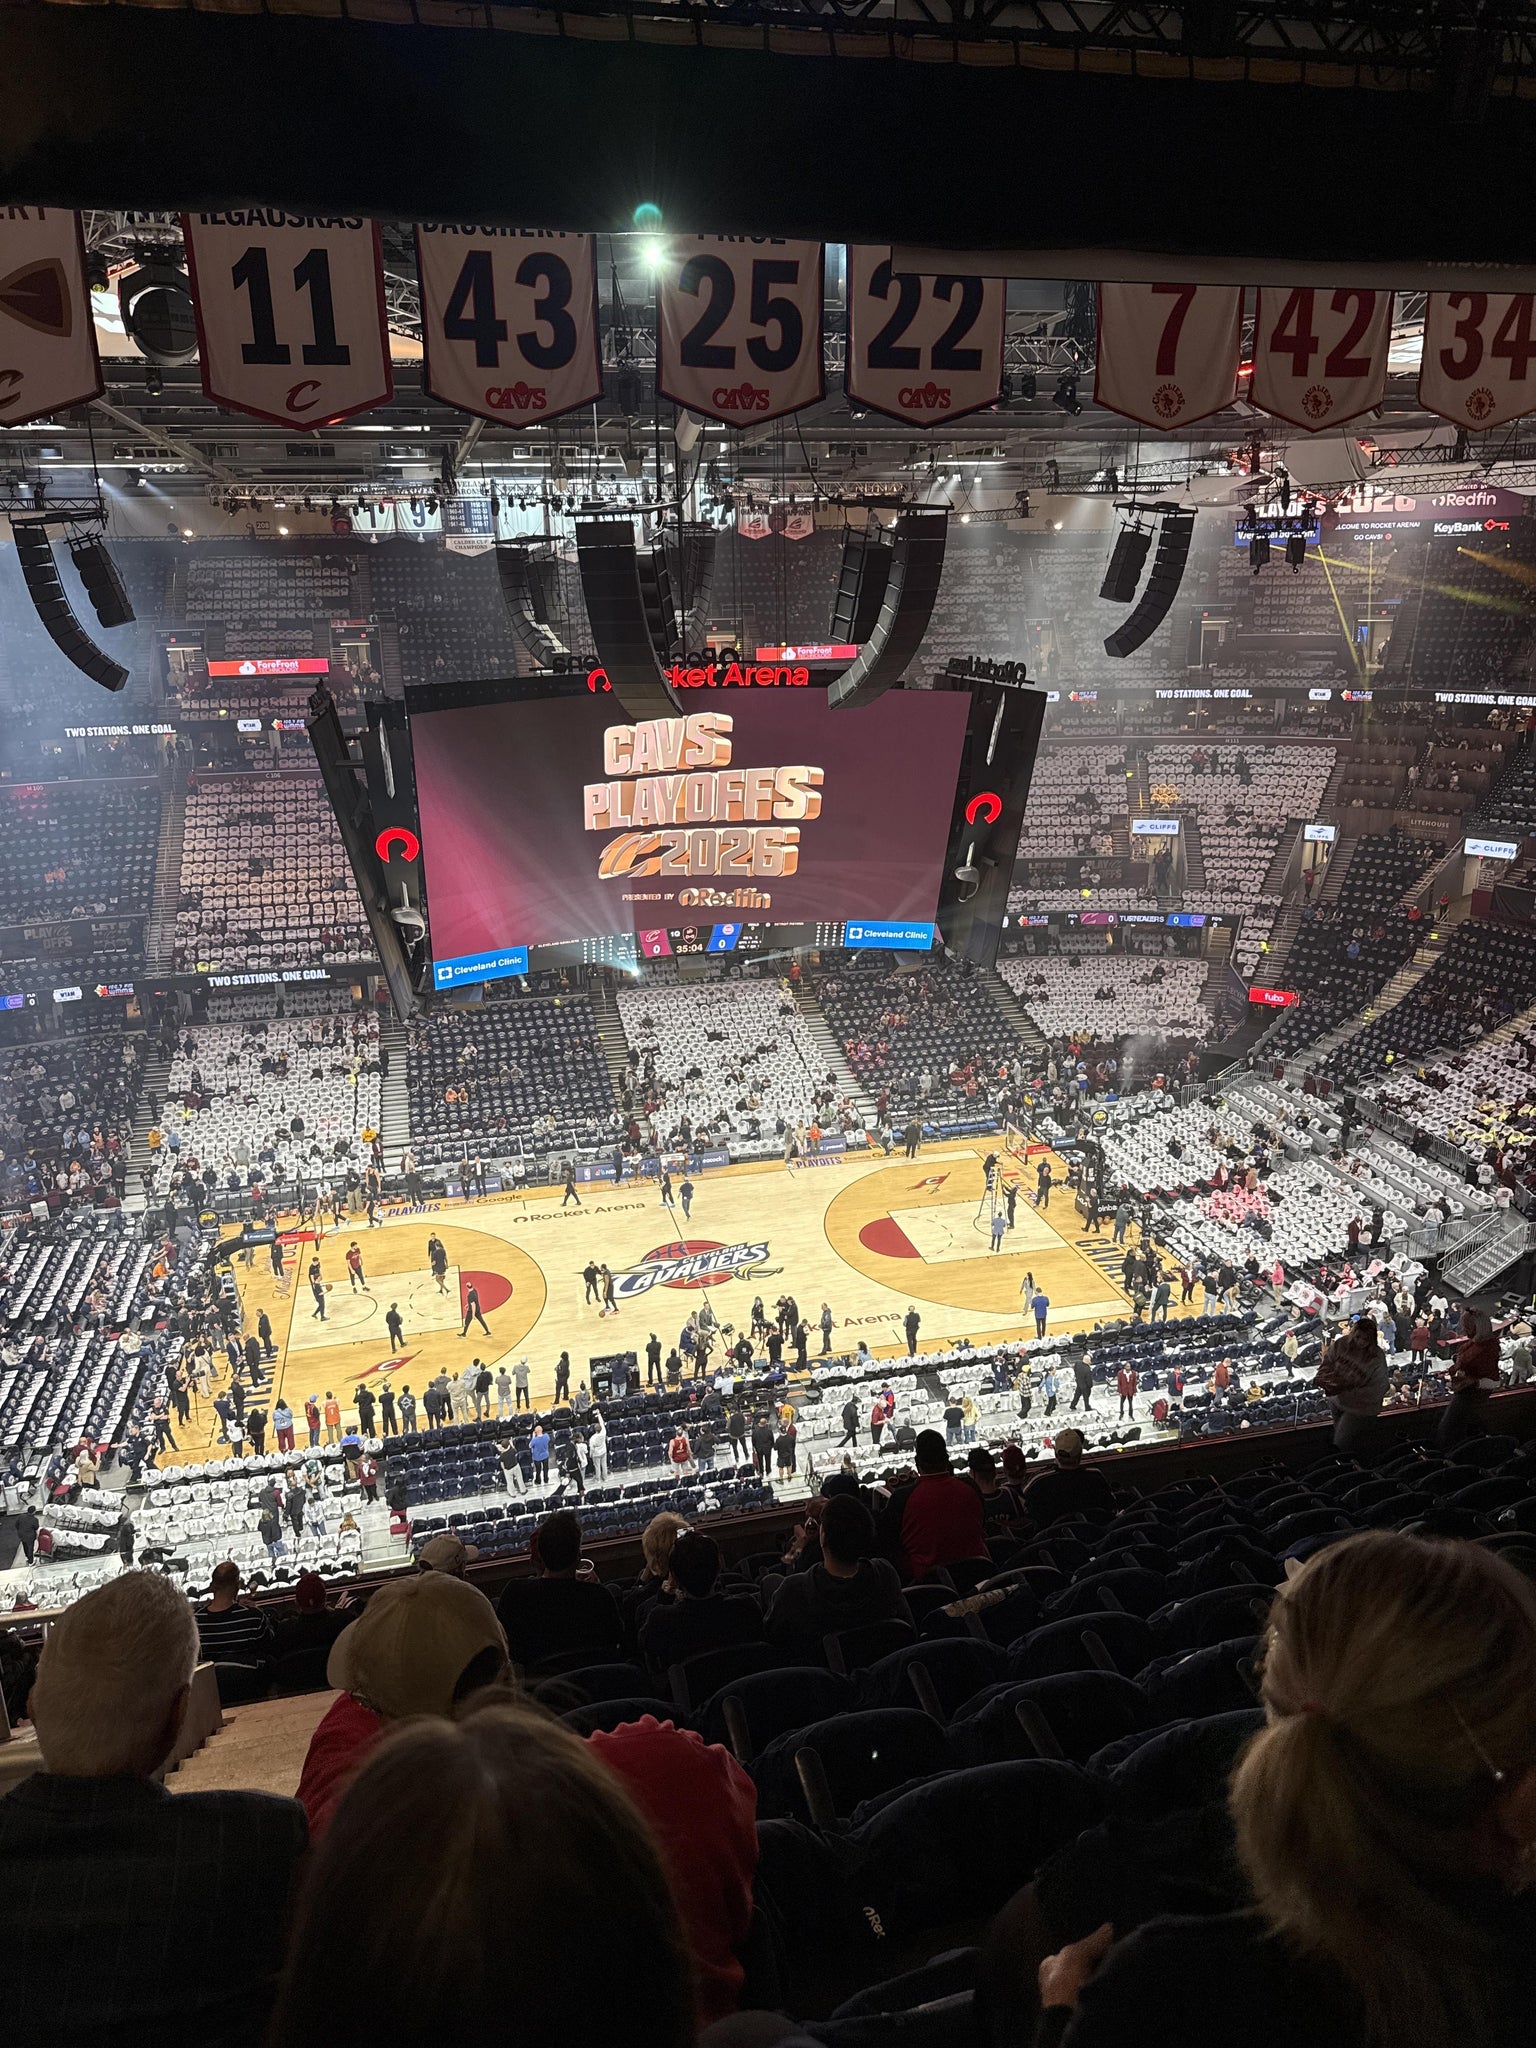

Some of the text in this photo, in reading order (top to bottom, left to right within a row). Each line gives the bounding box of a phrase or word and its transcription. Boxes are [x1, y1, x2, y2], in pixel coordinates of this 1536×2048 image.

[231, 246, 351, 366] 11
[443, 249, 578, 371] 43
[677, 254, 803, 372] 25
[867, 259, 984, 371] 22
[1151, 284, 1198, 376] 7
[1269, 290, 1377, 378] 42
[1439, 292, 1536, 381] 34
[485, 384, 548, 410] CAVS
[712, 385, 770, 411] CAVS
[898, 384, 952, 410] CAVS
[1446, 492, 1497, 506] Redfin
[1433, 521, 1483, 534] KeyBank
[797, 646, 833, 655] ForeFront
[257, 660, 299, 669] ForeFront
[722, 661, 809, 686] Arena
[1155, 689, 1253, 698] TWO STATIONS. ONE GOAL.
[1434, 692, 1454, 702] TWO
[1454, 693, 1497, 705] STATIONS.
[1497, 695, 1516, 705] ONE
[64, 723, 177, 738] TWO STATIONS. ONE GOAL.
[603, 712, 734, 776] CAVS
[583, 765, 825, 831] PLAYOFFS
[1410, 818, 1451, 829] LITEHOUSE
[659, 826, 801, 878] 2026
[1483, 844, 1515, 855] CLIFFS
[622, 893, 675, 901] PRESENTED BY
[697, 887, 772, 909] Redfin
[1108, 914, 1114, 924] 0
[1173, 915, 1179, 925] 0
[23, 927, 53, 941] PLAY
[670, 930, 681, 938] 1Q
[863, 930, 928, 940] Cleveland Clinic
[42, 936, 73, 951] OFFS
[652, 944, 661, 954] 0
[676, 943, 703, 954] 35:04
[718, 939, 726, 949] 0
[454, 956, 523, 976] Cleveland Clinic
[207, 968, 331, 987] TWO STATIONS. ONE GOAL.
[29, 998, 36, 1006] 0
[1264, 992, 1284, 1003] fubo
[796, 1156, 842, 1169] PLAYOFFS
[388, 1202, 441, 1217] PLAYOFFS
[476, 1193, 523, 1205] Google
[530, 1202, 646, 1223] Rocket Arena
[682, 1243, 745, 1265] CLEVELAND
[612, 1243, 770, 1299] CAVALIERS
[843, 1312, 903, 1328] Arena
